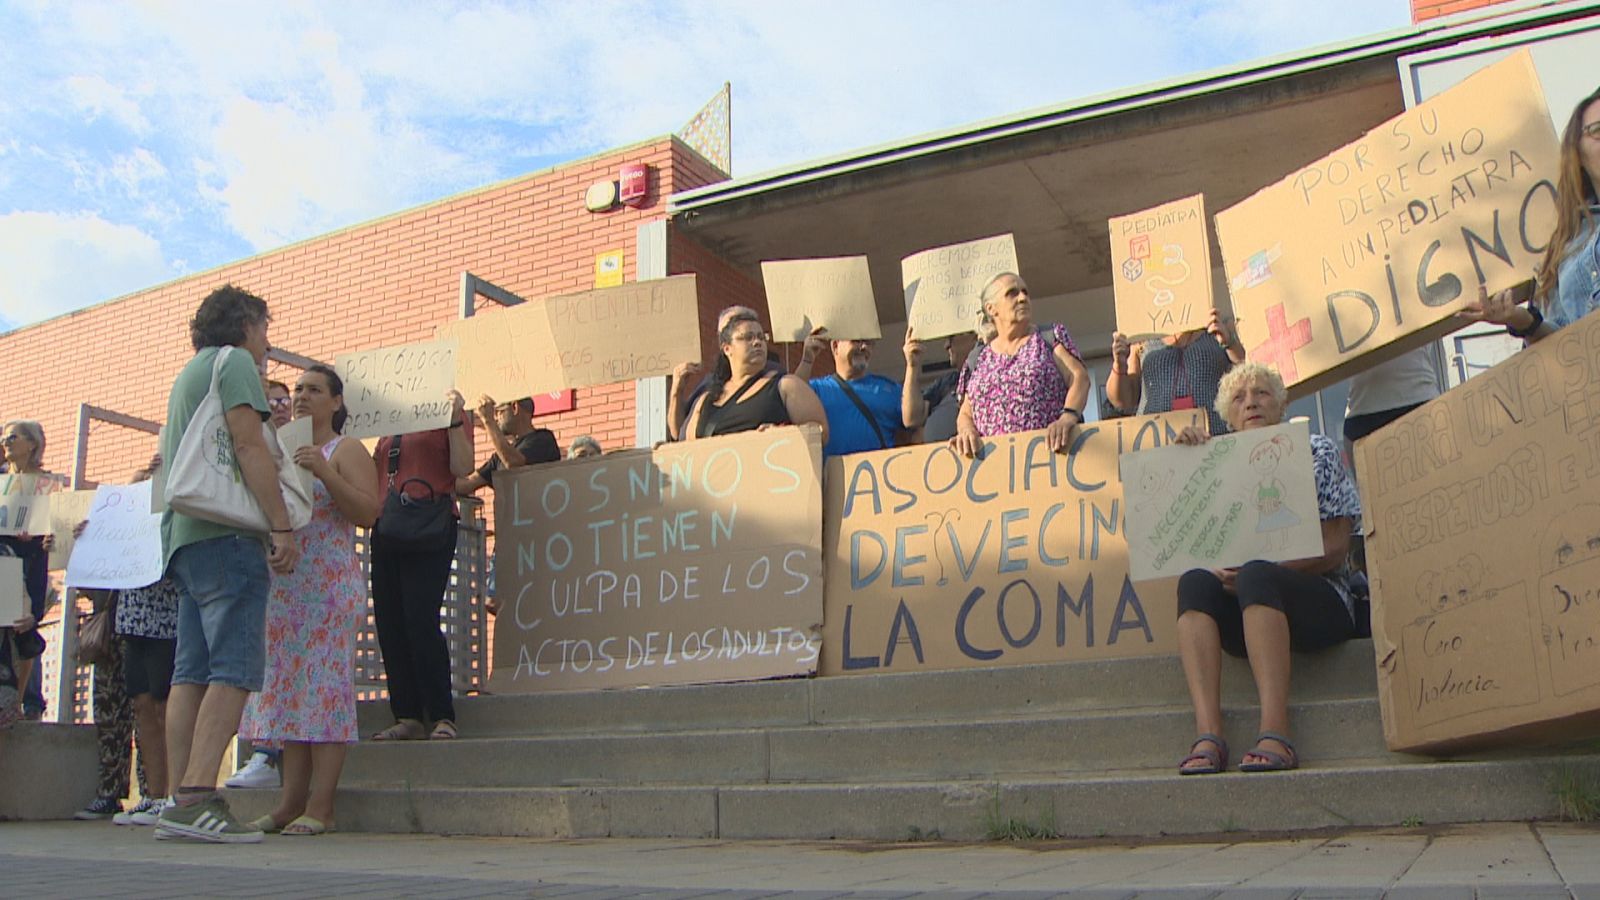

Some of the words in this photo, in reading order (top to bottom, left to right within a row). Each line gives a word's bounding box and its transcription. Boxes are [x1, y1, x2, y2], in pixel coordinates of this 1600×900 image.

[1293, 143, 1374, 206] POR
[1392, 108, 1438, 152] SU
[1339, 127, 1485, 226] DERECHO
[1321, 256, 1338, 285] A
[1342, 231, 1376, 270] UN
[1377, 149, 1533, 249] PEDIATRA
[512, 468, 611, 526] LOS
[514, 570, 642, 630] CULPA
[658, 566, 700, 603] DE
[722, 549, 809, 596] LOS
[517, 532, 573, 576] NO
[850, 524, 929, 591] DE
[945, 498, 1128, 583] VECIN
[513, 636, 618, 681] ACTOS
[842, 597, 925, 671] LA
[954, 572, 1154, 661] COMA
